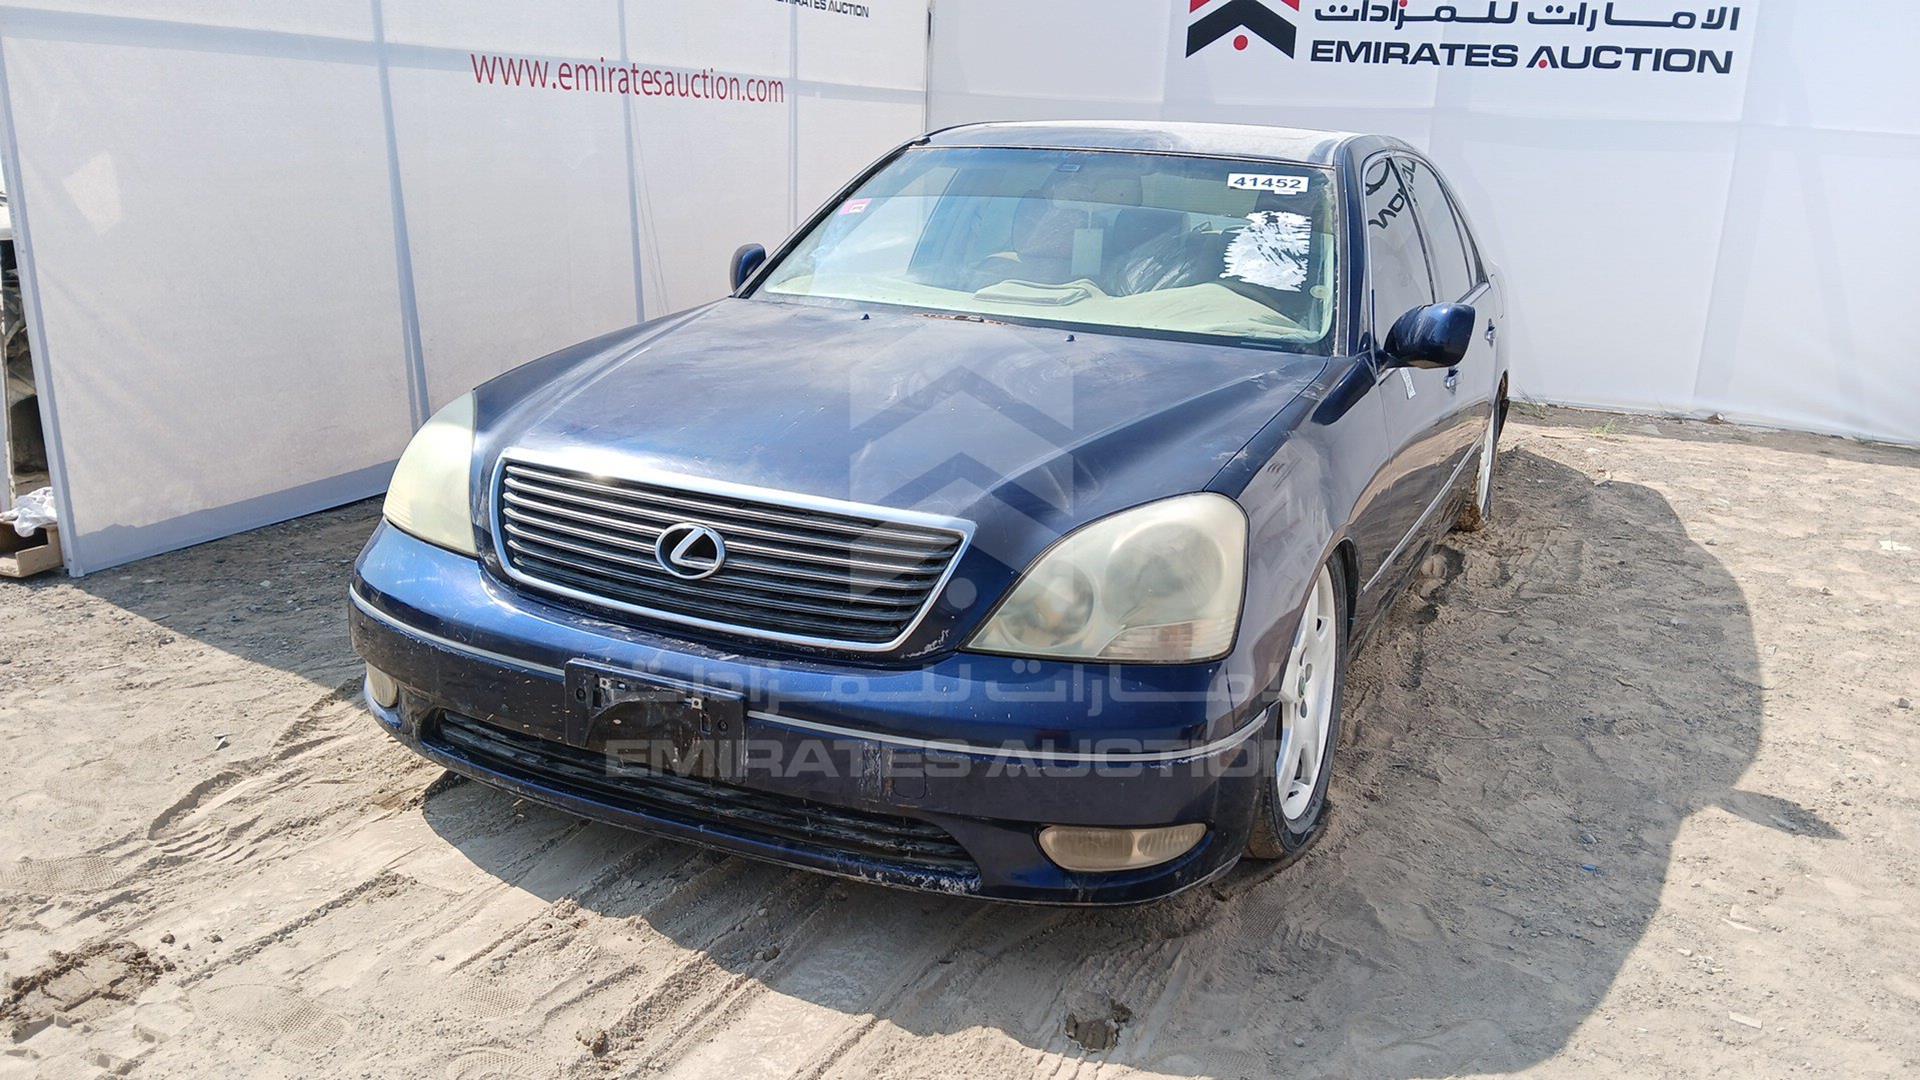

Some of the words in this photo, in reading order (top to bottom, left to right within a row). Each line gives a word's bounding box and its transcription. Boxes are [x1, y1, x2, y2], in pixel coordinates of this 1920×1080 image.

[776, 0, 826, 10] RATES
[828, 1, 869, 18] AUCTION
[1311, 40, 1519, 67] EMIRATES
[1526, 45, 1733, 74] AUCTION
[471, 53, 784, 103] www.emiratesauction.com
[1234, 176, 1302, 189] 41452
